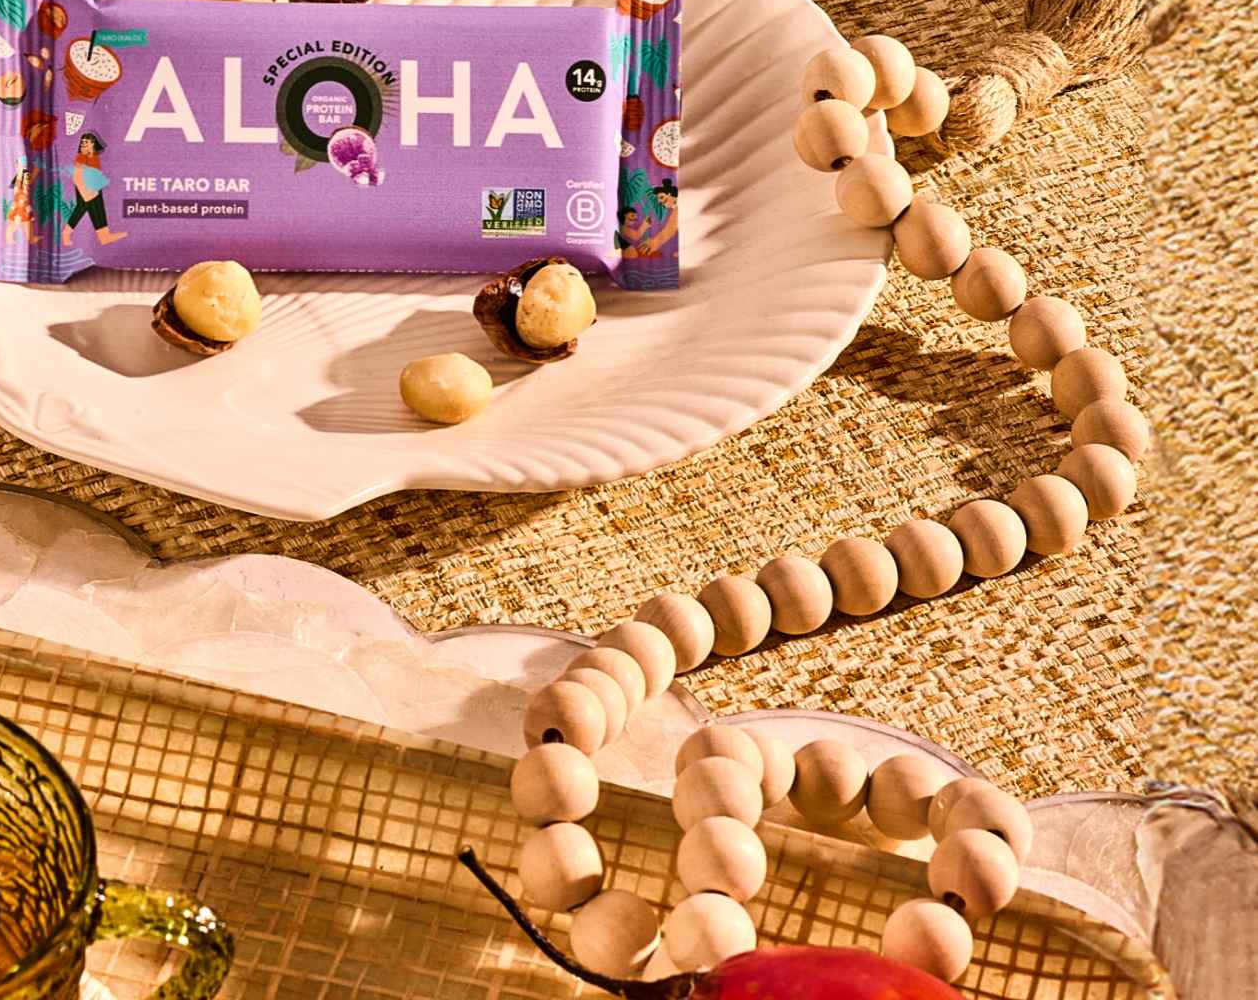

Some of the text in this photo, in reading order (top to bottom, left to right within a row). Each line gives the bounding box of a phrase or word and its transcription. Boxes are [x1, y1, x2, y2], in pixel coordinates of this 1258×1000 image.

[263, 40, 397, 86] SPECIAL EDITION
[124, 55, 565, 163] ALOHA
[305, 104, 354, 114] PROTEIN
[318, 115, 342, 124] BAR
[123, 177, 250, 193] THE TARO BAR
[516, 190, 543, 200] NON
[127, 202, 245, 216] plant-based protein
[576, 198, 596, 222] B
[485, 218, 544, 230] VERIFIED
